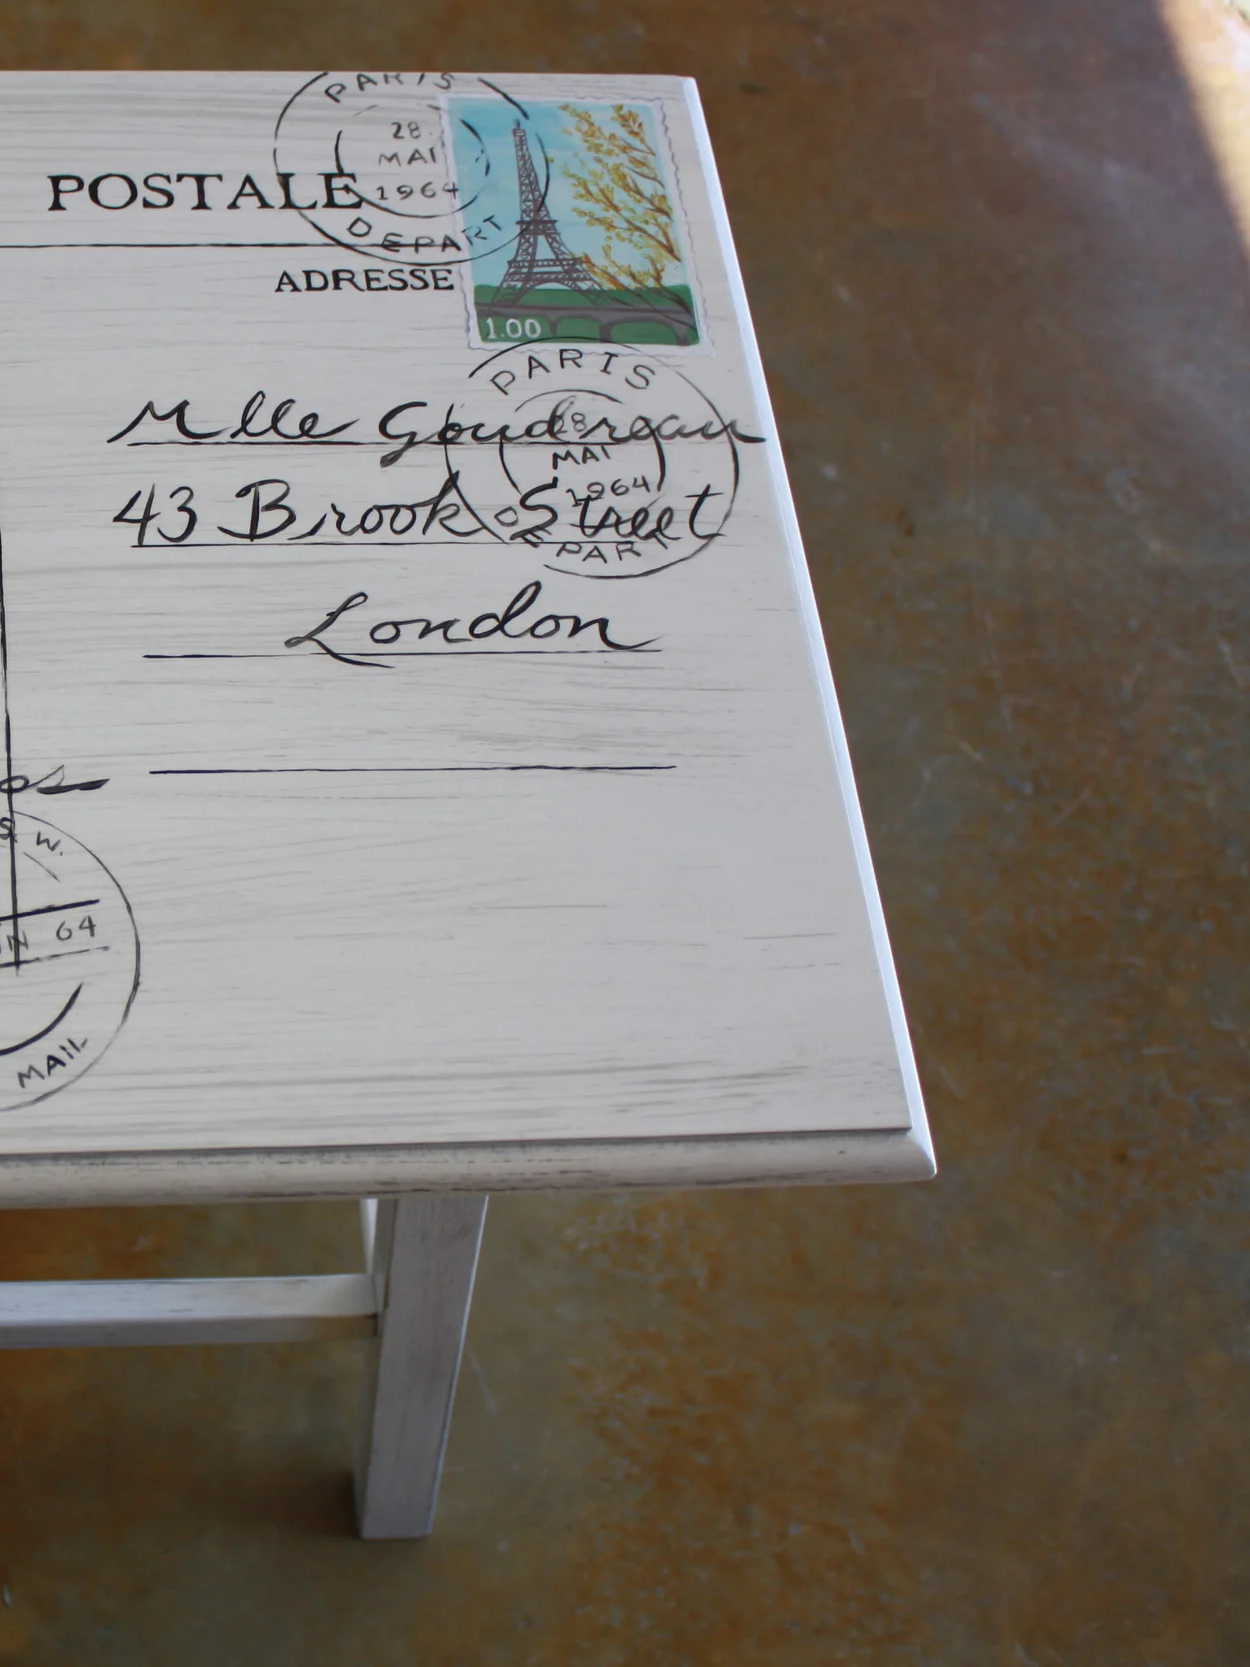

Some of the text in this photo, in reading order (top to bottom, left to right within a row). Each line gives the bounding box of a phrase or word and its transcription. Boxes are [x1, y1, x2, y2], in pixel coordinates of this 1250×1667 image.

[378, 146, 437, 168] MAI
[48, 172, 364, 211] POSTALE
[376, 181, 459, 201] 1964
[346, 214, 503, 254] DEPART
[275, 268, 454, 293] ADRESSE
[486, 317, 541, 340] 1.00
[490, 348, 655, 396] PARIS
[112, 482, 198, 546] 43
[216, 470, 490, 543] Brook
[283, 579, 662, 669] London
[56, 915, 97, 942] 64
[17, 1037, 88, 1089] MAIL
